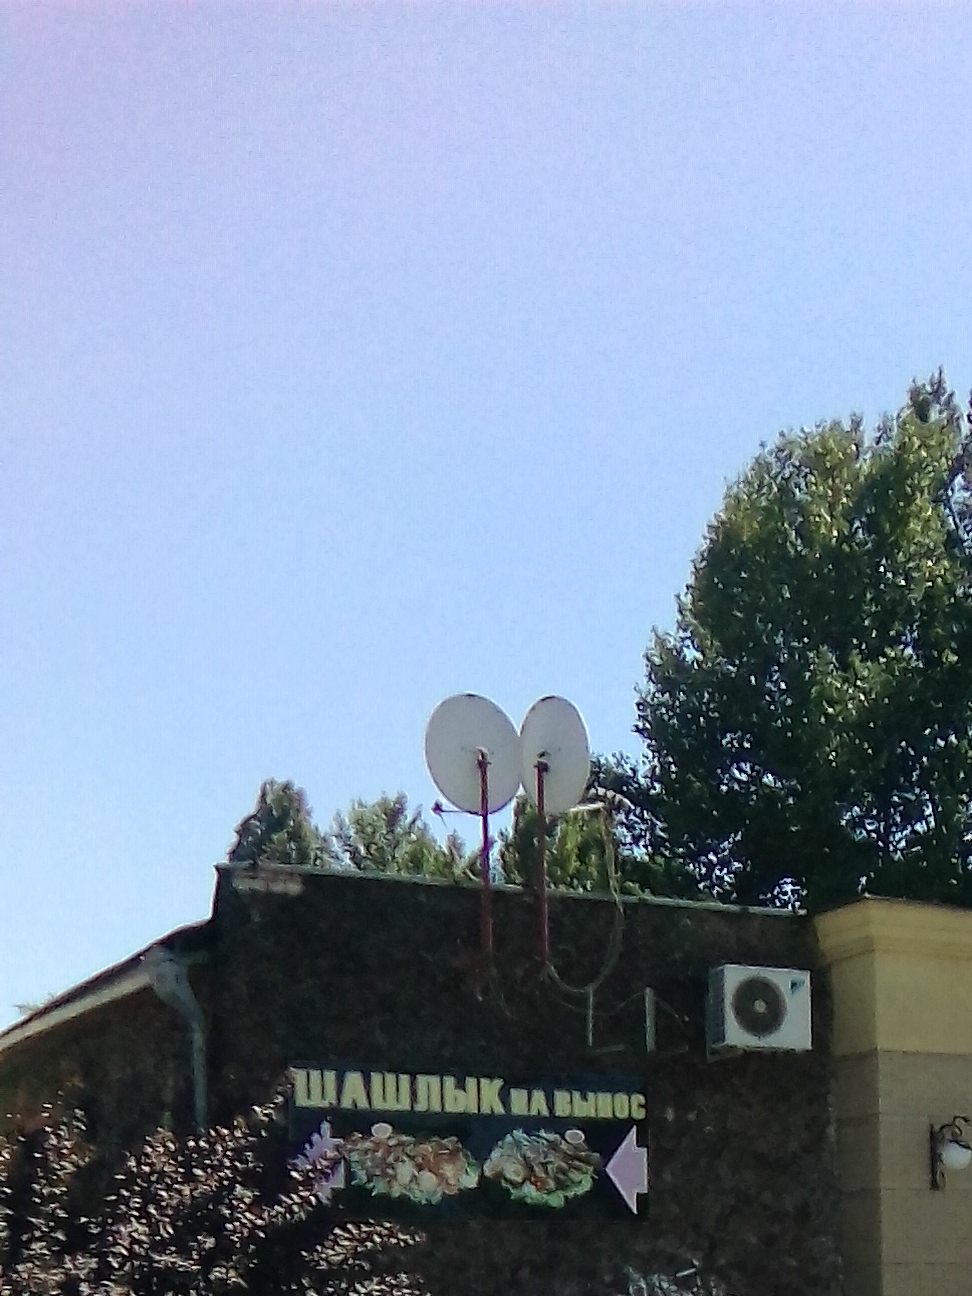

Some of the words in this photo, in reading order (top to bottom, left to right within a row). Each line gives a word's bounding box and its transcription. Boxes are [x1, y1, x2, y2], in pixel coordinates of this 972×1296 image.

[293, 1067, 505, 1115] ШАШЛЫК
[510, 1087, 549, 1117] НА
[554, 1089, 647, 1120] ВЫНОС
